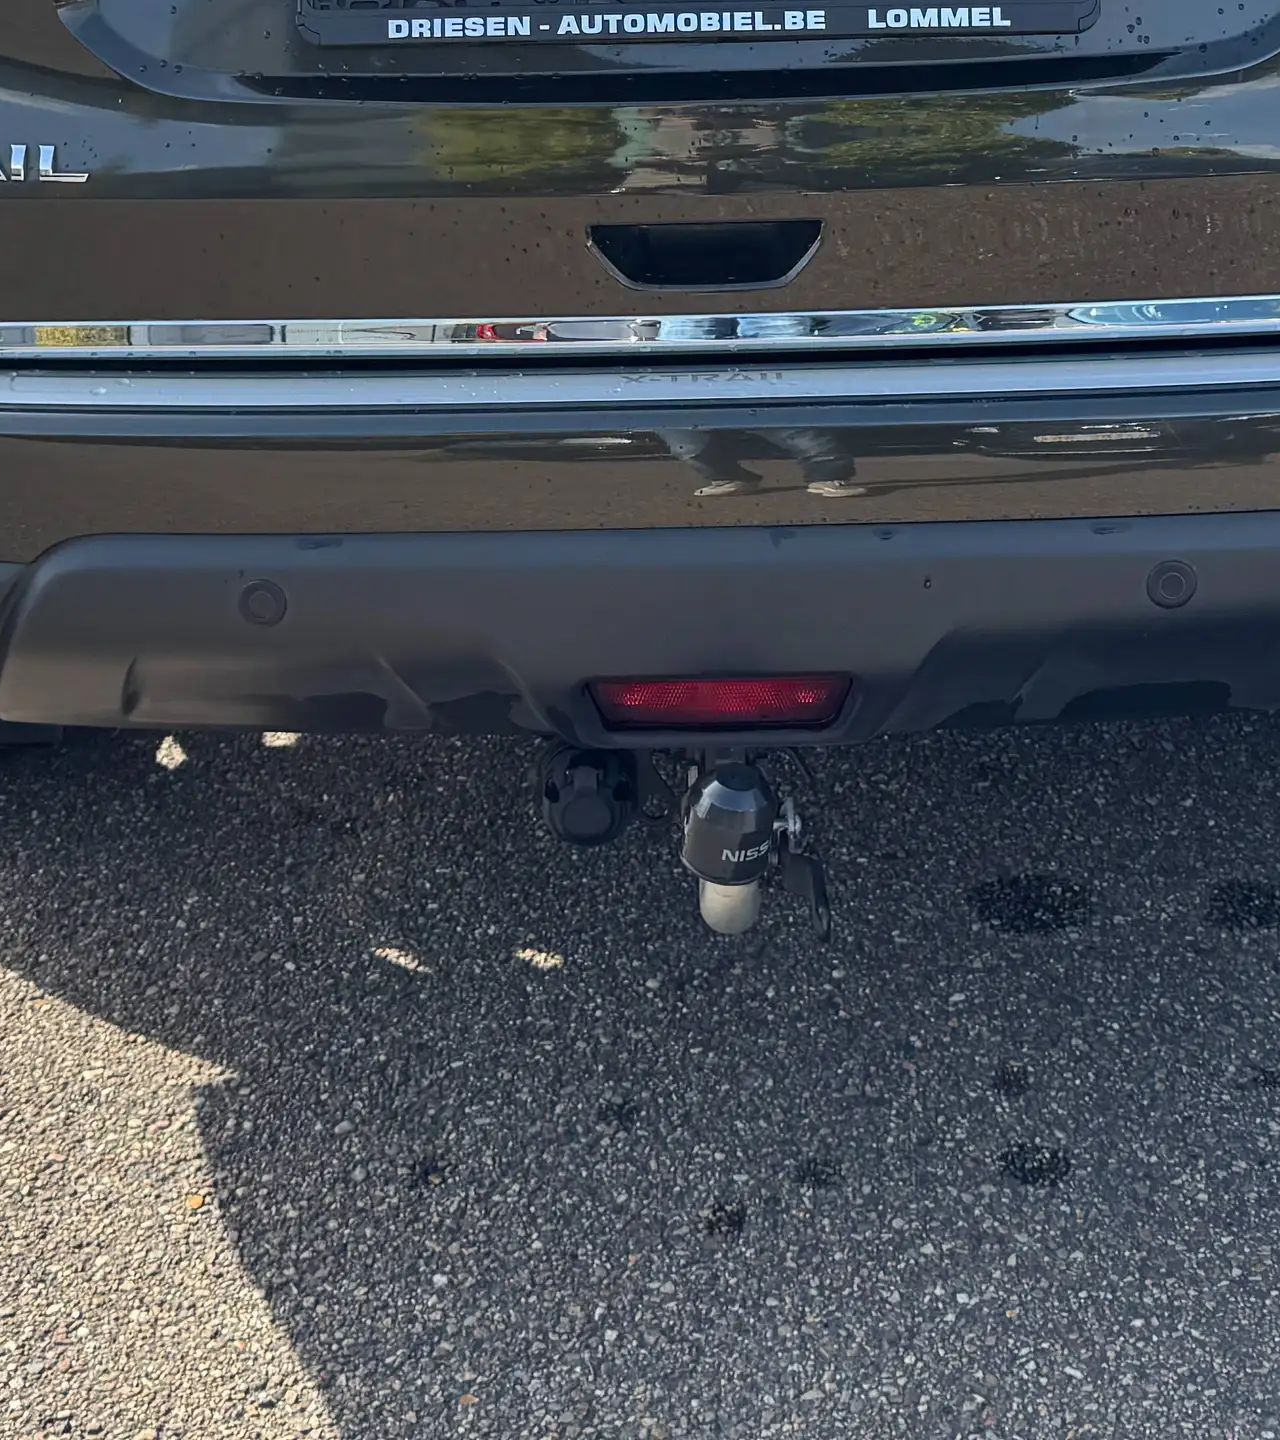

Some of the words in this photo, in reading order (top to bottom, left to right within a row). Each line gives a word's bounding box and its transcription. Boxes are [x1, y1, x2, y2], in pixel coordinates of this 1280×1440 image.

[388, 16, 531, 39] DRIESEN
[557, 10, 826, 35] AUTOMOBIEL.BE
[868, 7, 1011, 28] LOMMEL
